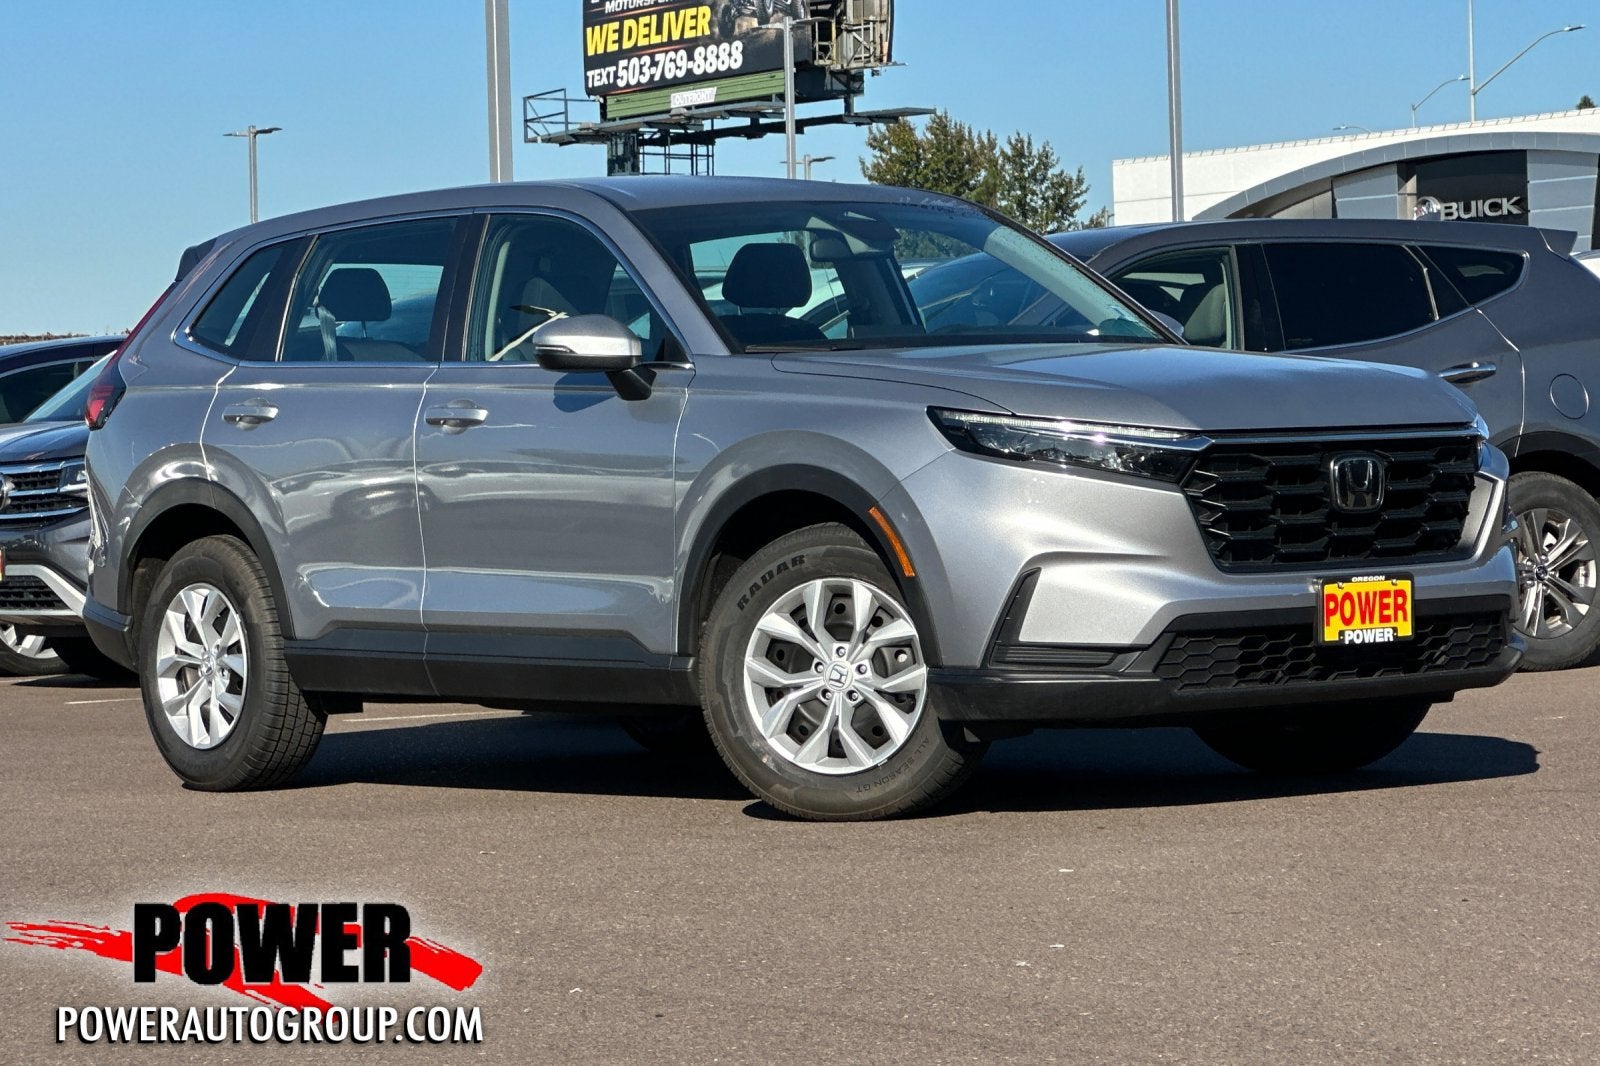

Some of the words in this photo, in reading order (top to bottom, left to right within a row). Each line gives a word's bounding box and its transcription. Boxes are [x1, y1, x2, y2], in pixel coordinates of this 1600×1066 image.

[586, 21, 620, 56] WE
[622, 5, 711, 49] DELIVER
[586, 66, 616, 88] TEXT
[616, 40, 743, 87] 503-769-8888
[1440, 196, 1522, 221] BUICK
[737, 554, 806, 611] RADAR
[1351, 575, 1385, 583] OREGON
[1325, 589, 1408, 627] POWER
[1344, 628, 1394, 645] POWER
